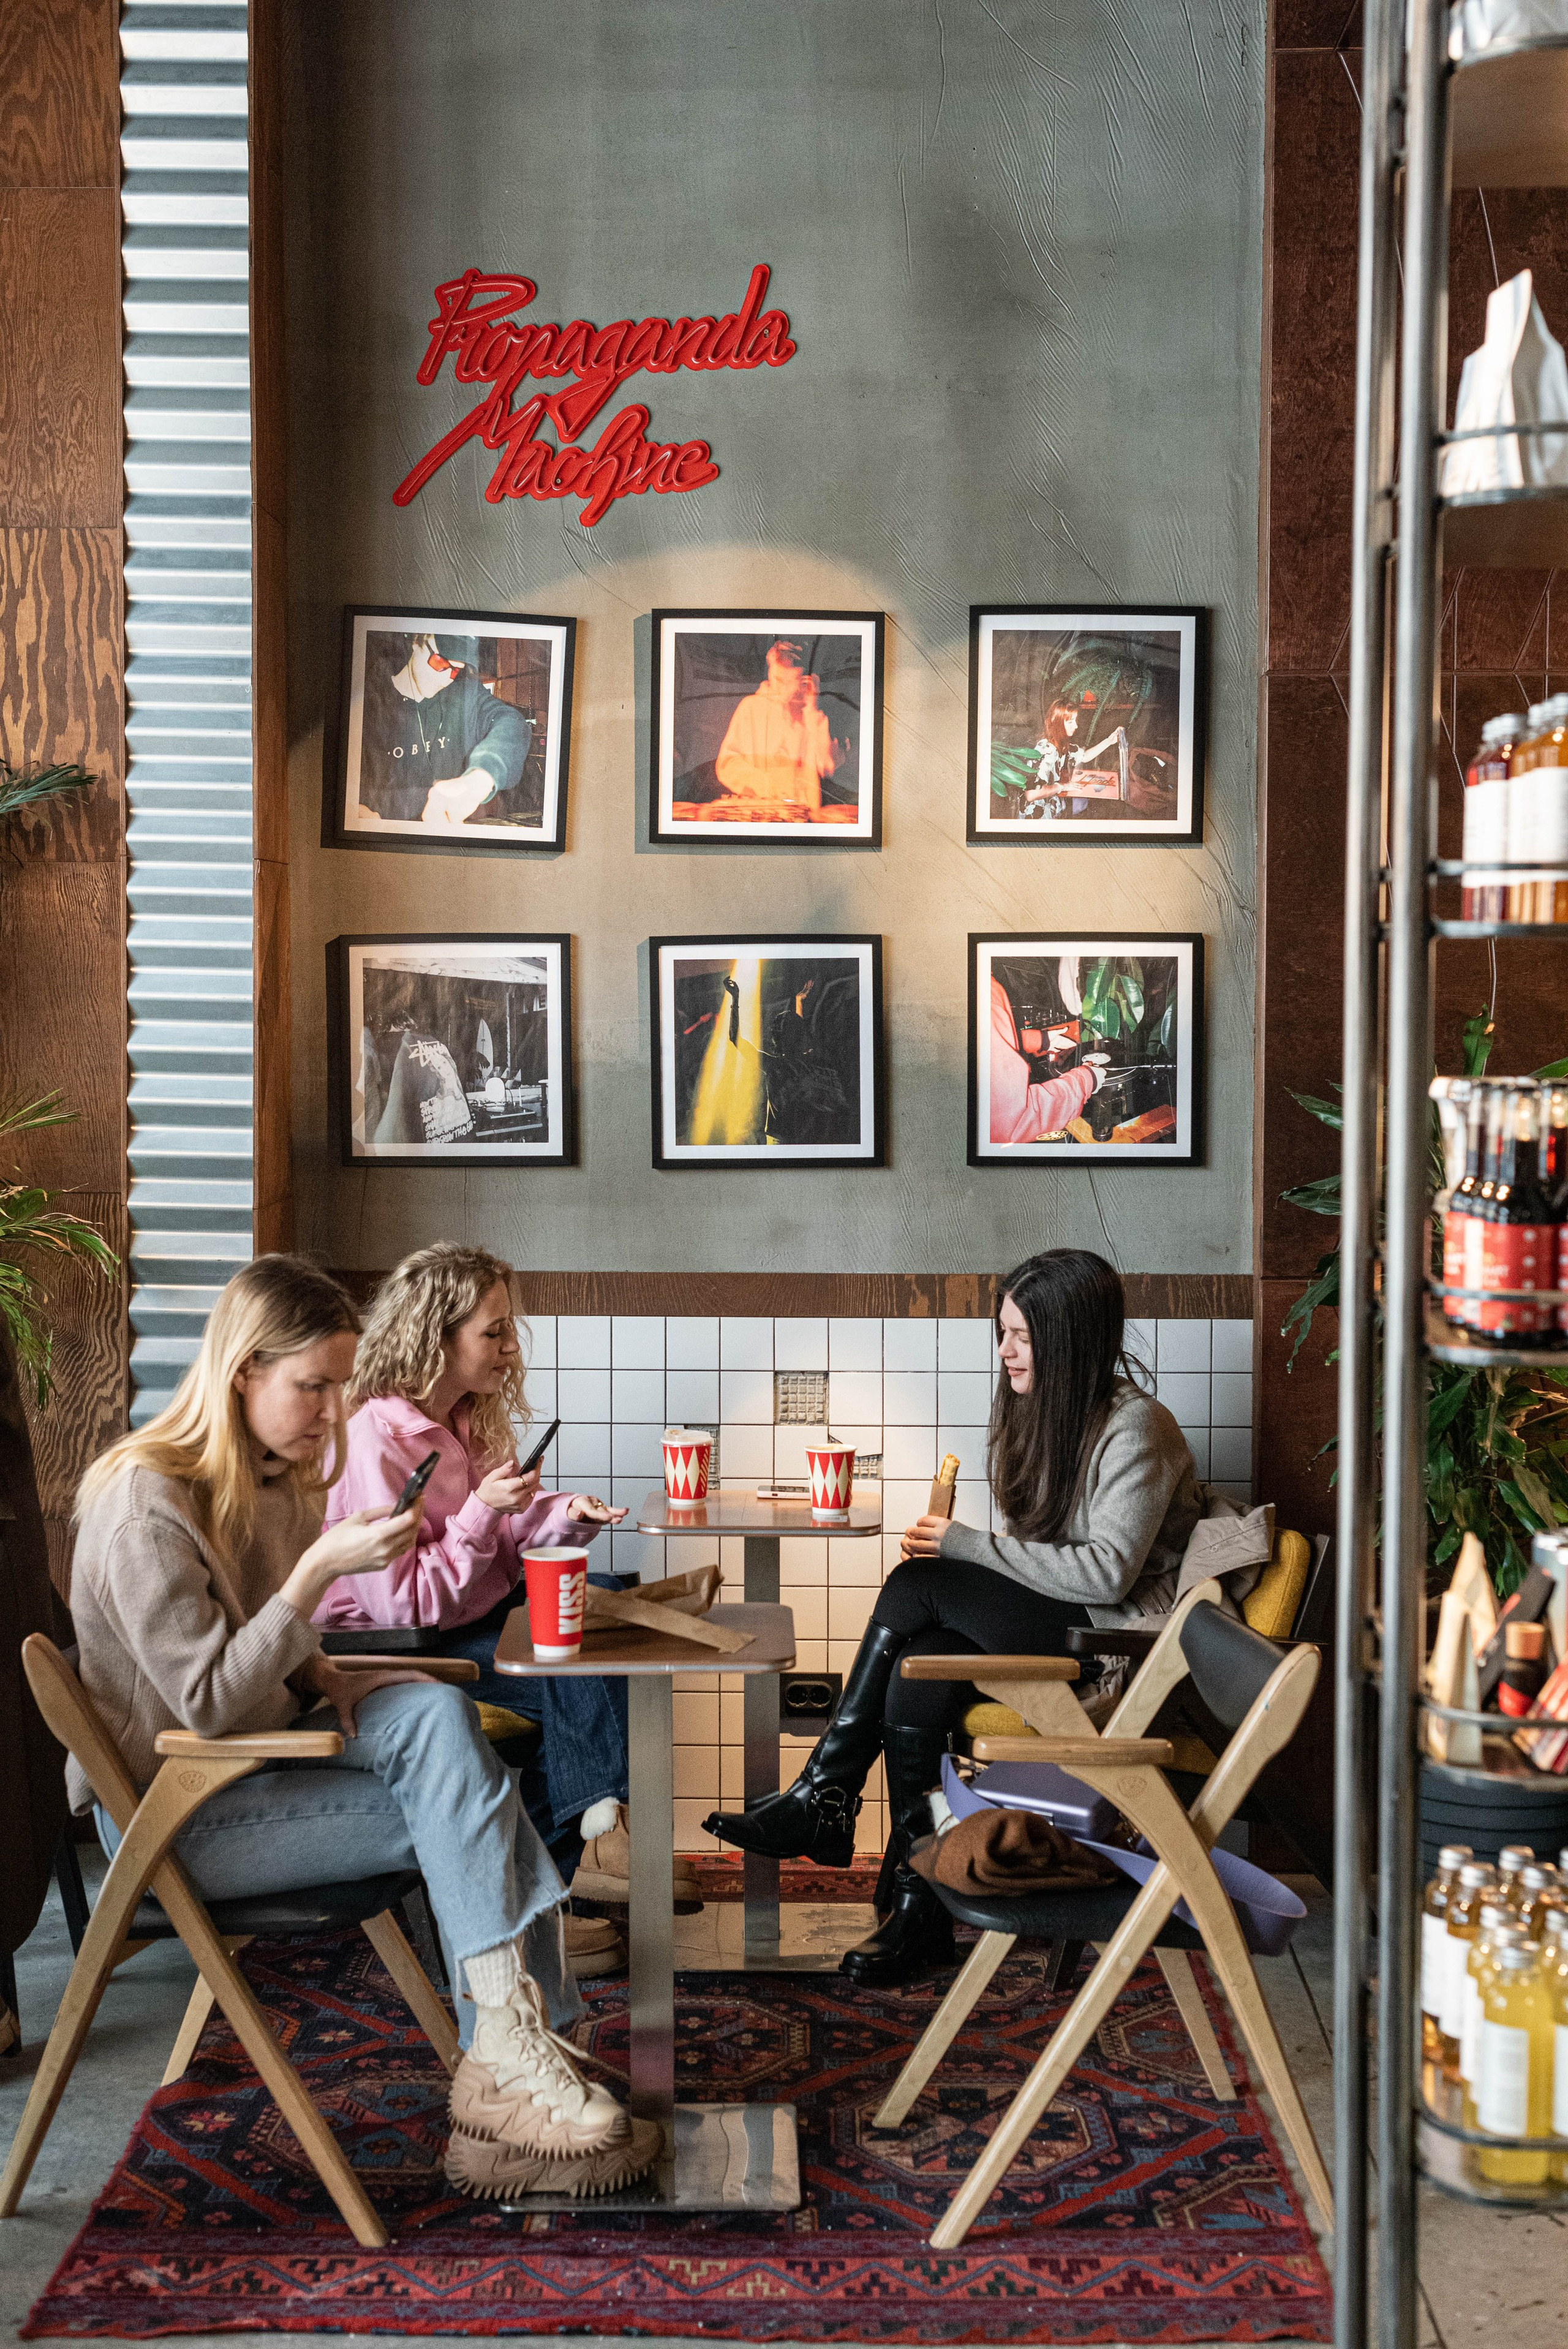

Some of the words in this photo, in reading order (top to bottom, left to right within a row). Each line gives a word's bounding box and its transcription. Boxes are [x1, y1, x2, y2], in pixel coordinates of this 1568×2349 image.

[417, 263, 796, 443] Propaganda
[393, 393, 719, 527] Machine
[393, 737, 446, 758] OBEY
[559, 1570, 586, 1635] KISS
